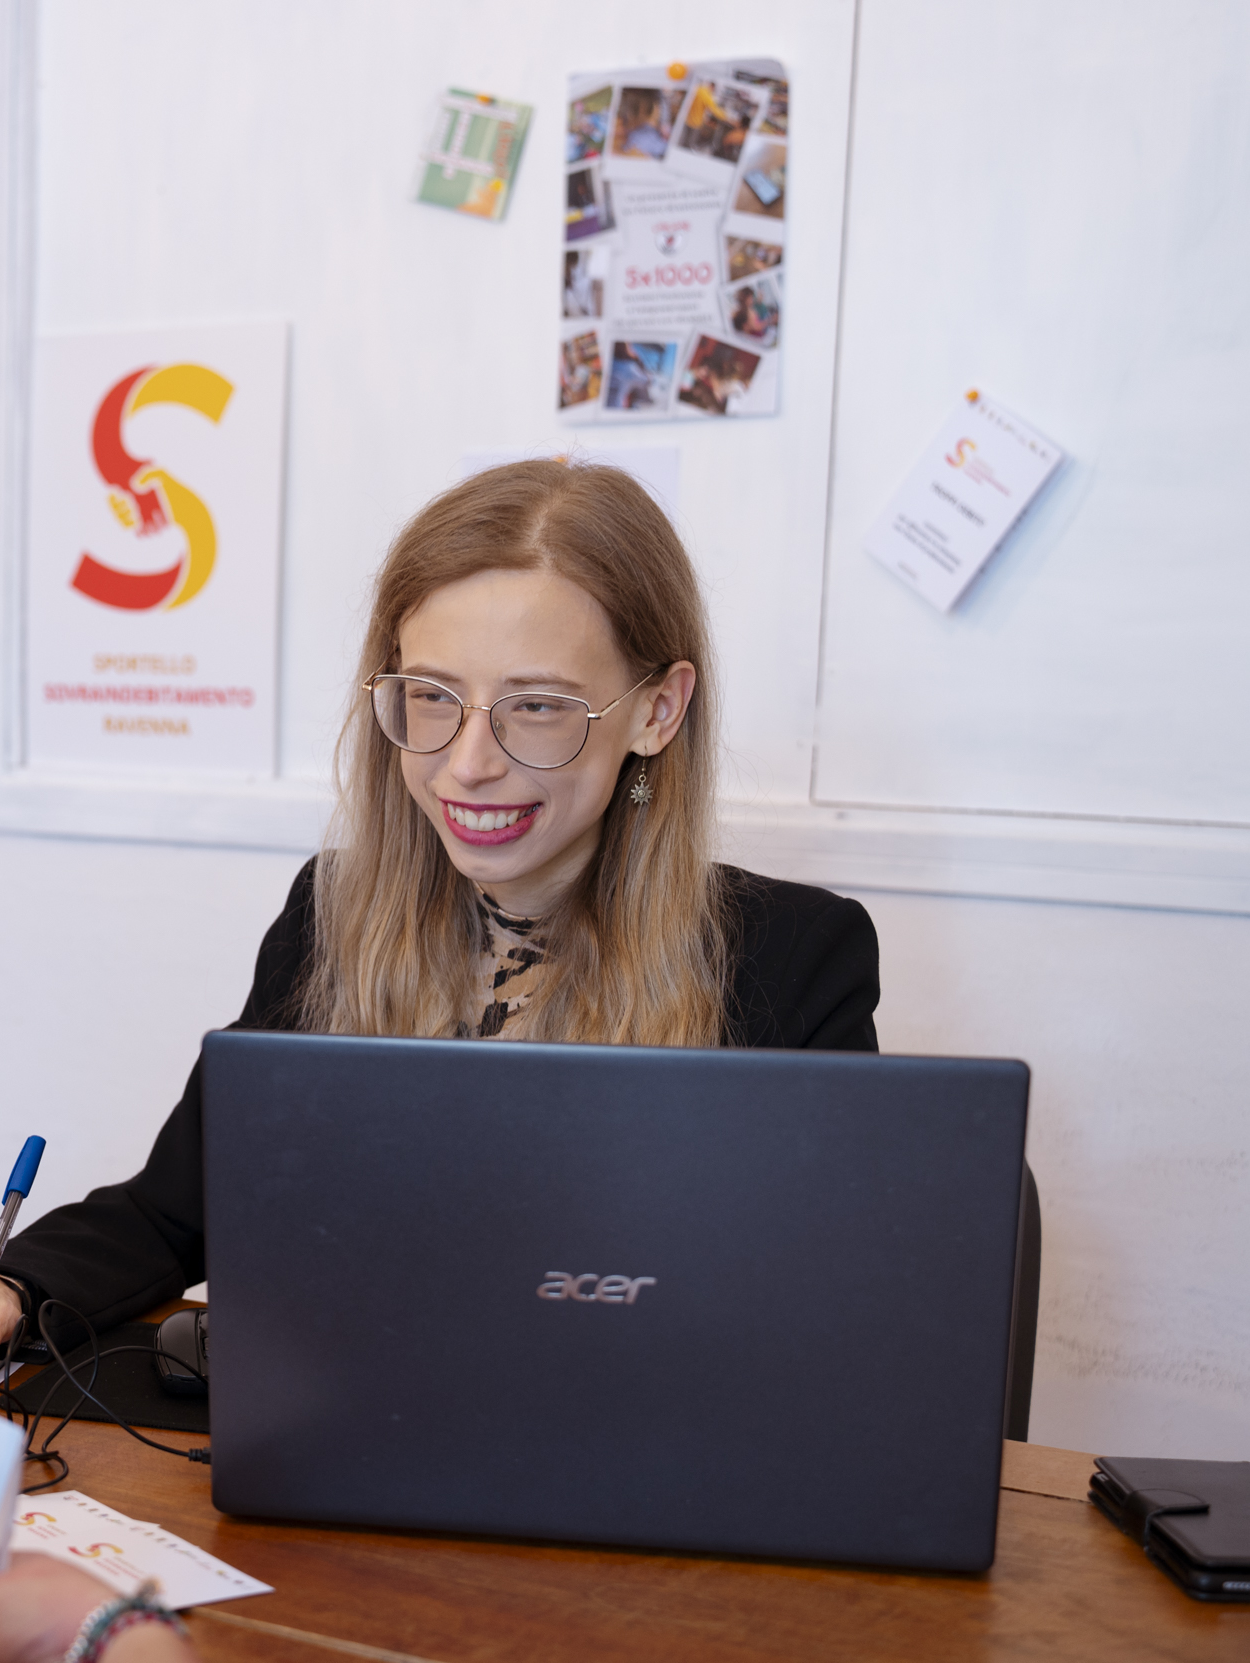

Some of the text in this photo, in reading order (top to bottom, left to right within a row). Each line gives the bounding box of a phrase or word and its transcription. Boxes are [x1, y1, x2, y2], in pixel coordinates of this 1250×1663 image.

[93, 653, 197, 676] SPORTELLO
[103, 714, 191, 736] RAVENNA
[536, 1270, 658, 1305] acer
